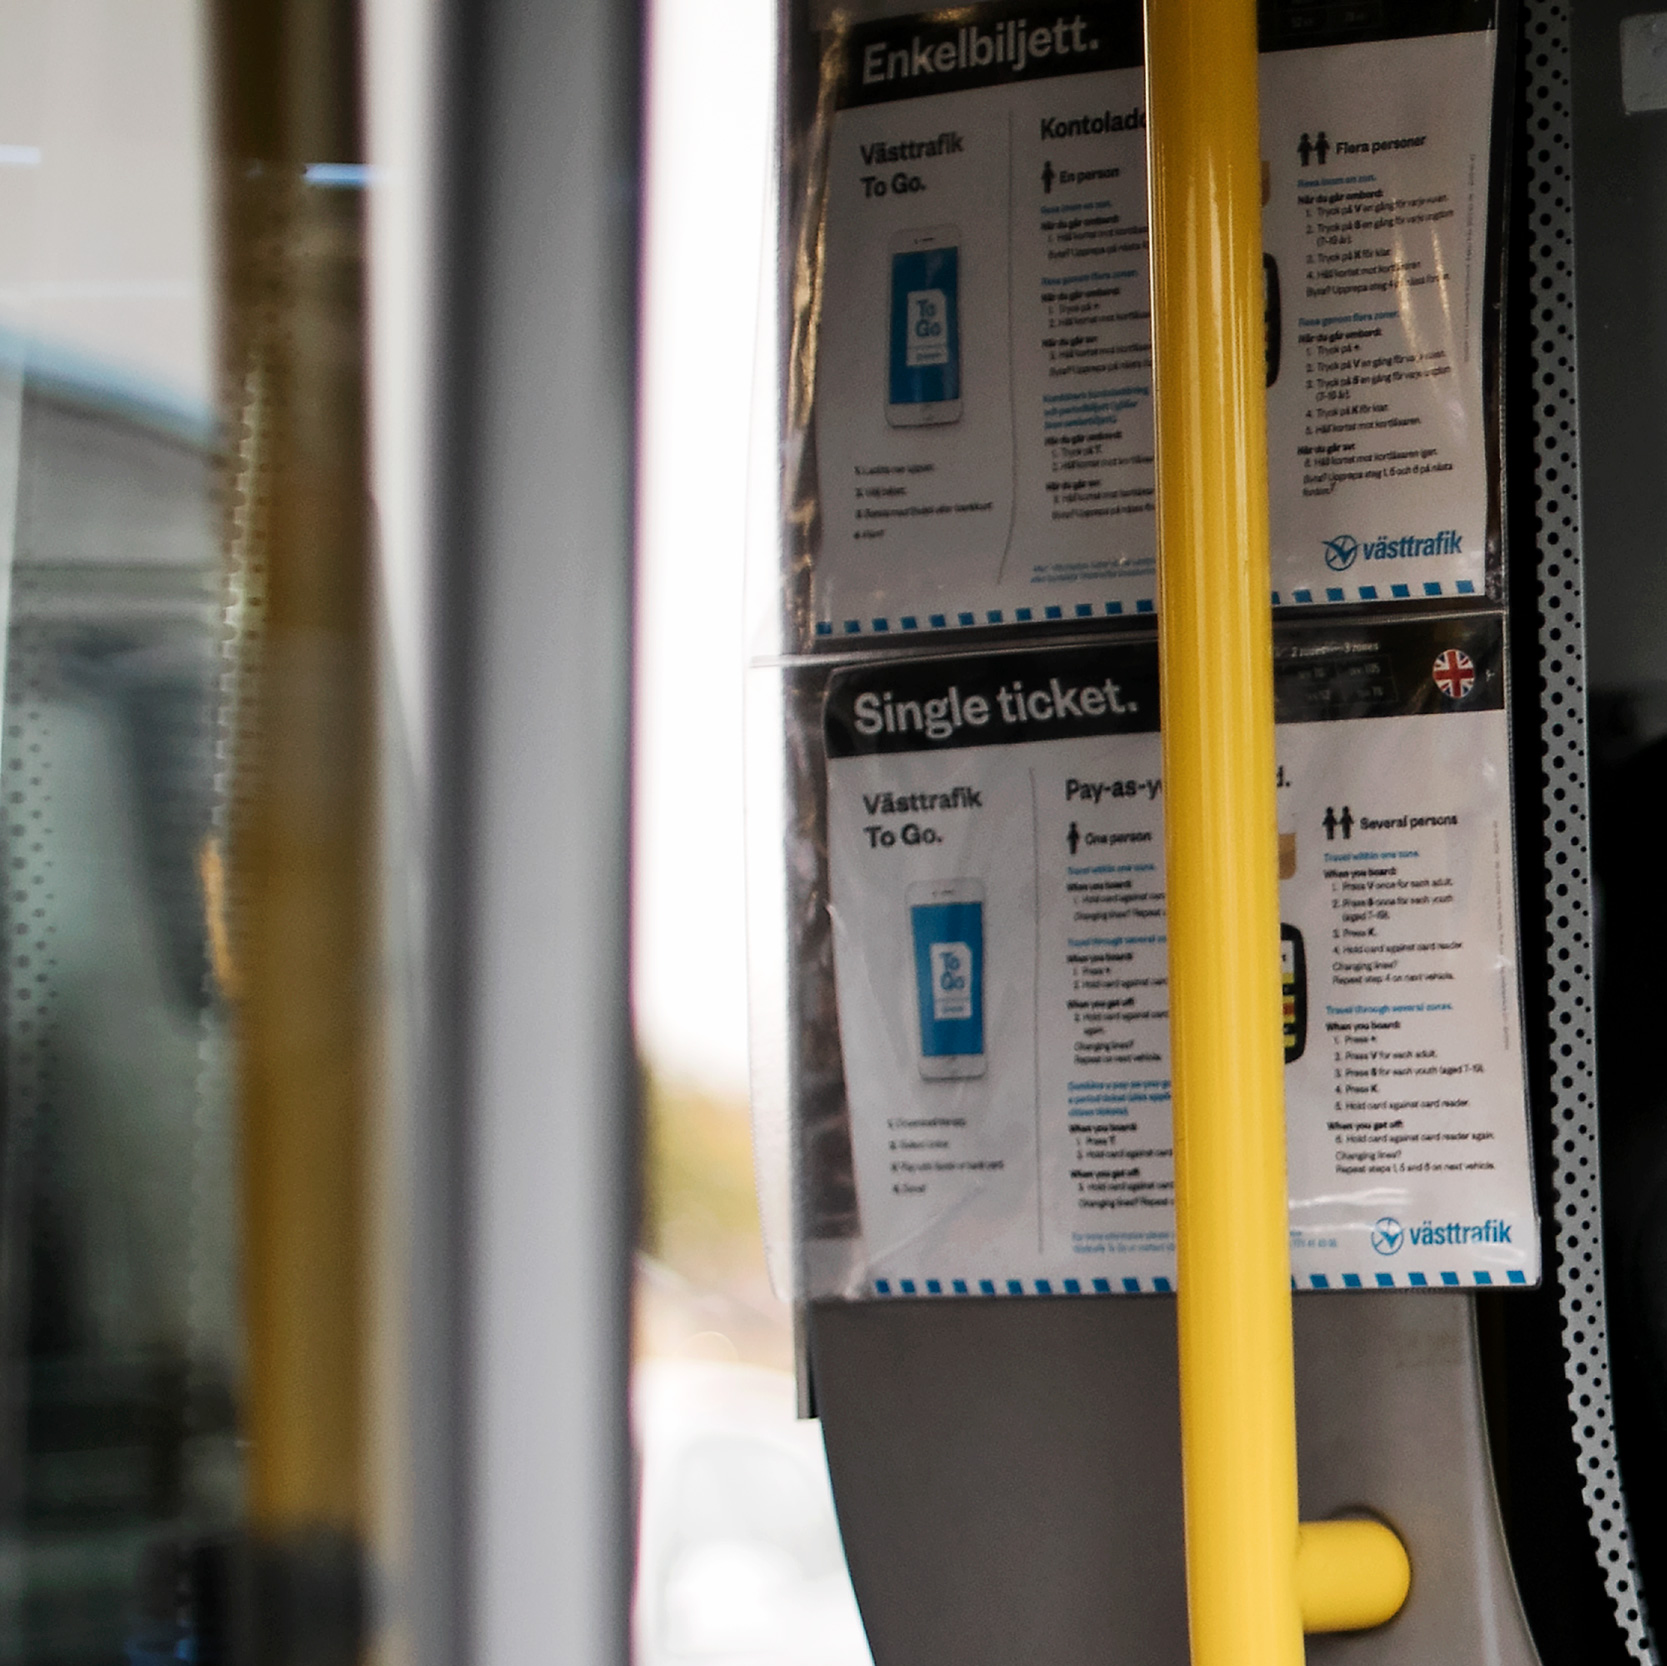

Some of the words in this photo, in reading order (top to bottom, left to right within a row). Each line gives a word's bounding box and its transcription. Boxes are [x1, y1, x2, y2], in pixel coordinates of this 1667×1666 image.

[863, 15, 1098, 84] Enkelbiljett.
[860, 131, 964, 166] Västtrafik
[1336, 142, 1370, 155] Flera
[1372, 135, 1427, 154] personer
[861, 177, 887, 197] To
[892, 173, 926, 194] Go.
[917, 300, 936, 317] To
[915, 320, 941, 337] Go
[1363, 530, 1462, 560] västtrafik
[854, 686, 989, 739] Single
[996, 678, 1137, 723] ticket.
[863, 787, 982, 815] Västtrafik
[1066, 779, 1162, 803] Pay-as-y
[1360, 815, 1407, 830] Several
[1410, 815, 1458, 829] persons
[864, 826, 895, 848] To
[901, 823, 942, 846] Go.
[940, 952, 960, 970] To
[941, 971, 965, 990] Go
[1410, 1220, 1512, 1245] västtrafik
